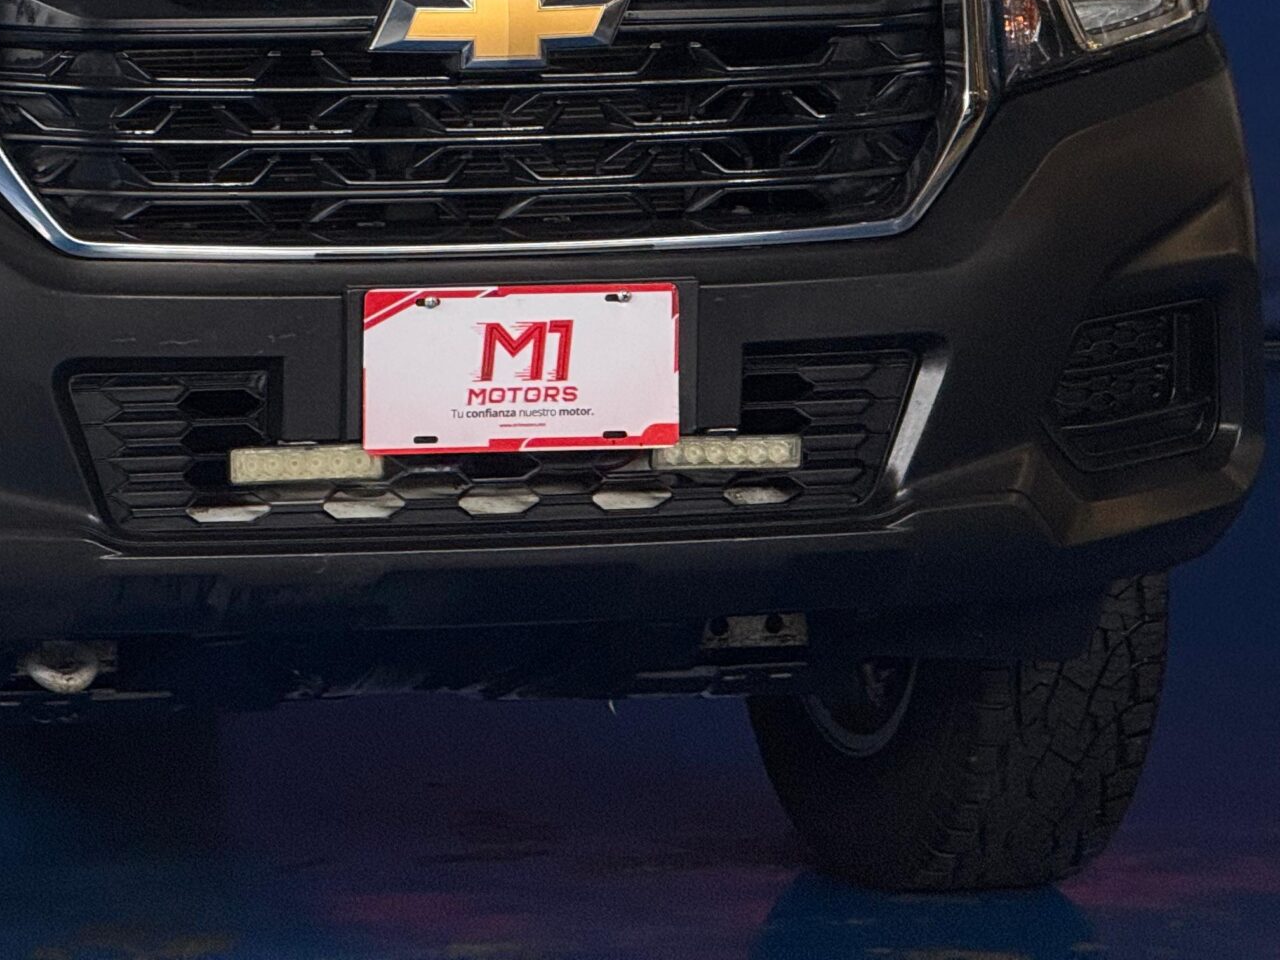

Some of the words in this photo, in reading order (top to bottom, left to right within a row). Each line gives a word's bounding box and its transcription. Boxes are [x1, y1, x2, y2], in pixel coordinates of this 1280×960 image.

[474, 320, 574, 381] M1
[466, 386, 578, 406] MOTORS
[451, 409, 464, 418] Tu
[466, 408, 517, 418] confianza
[519, 408, 557, 417] nuestro
[559, 407, 595, 417] motor.
